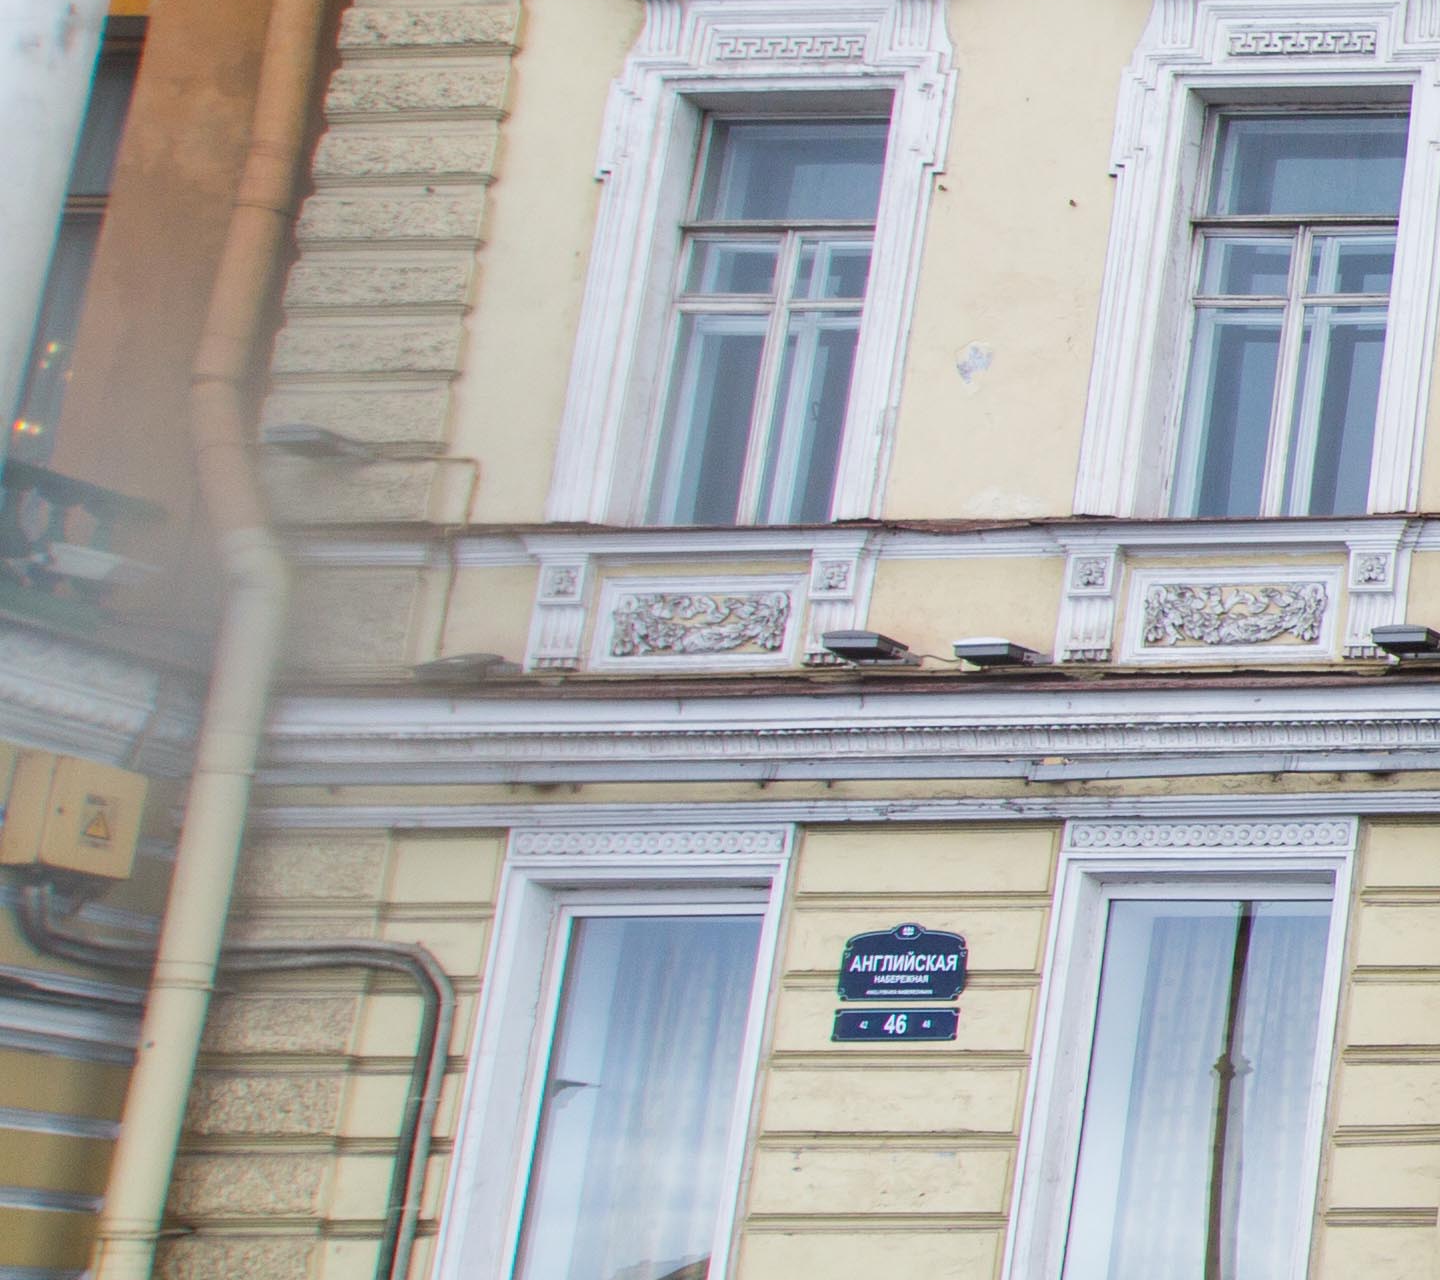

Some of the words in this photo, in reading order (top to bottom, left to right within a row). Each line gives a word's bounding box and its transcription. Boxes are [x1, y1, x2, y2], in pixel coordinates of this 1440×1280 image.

[849, 951, 958, 972] АНГЛИЙСКАЯ
[874, 975, 929, 983] НАБЕРЕЖНАЯ
[883, 1014, 907, 1034] 46
